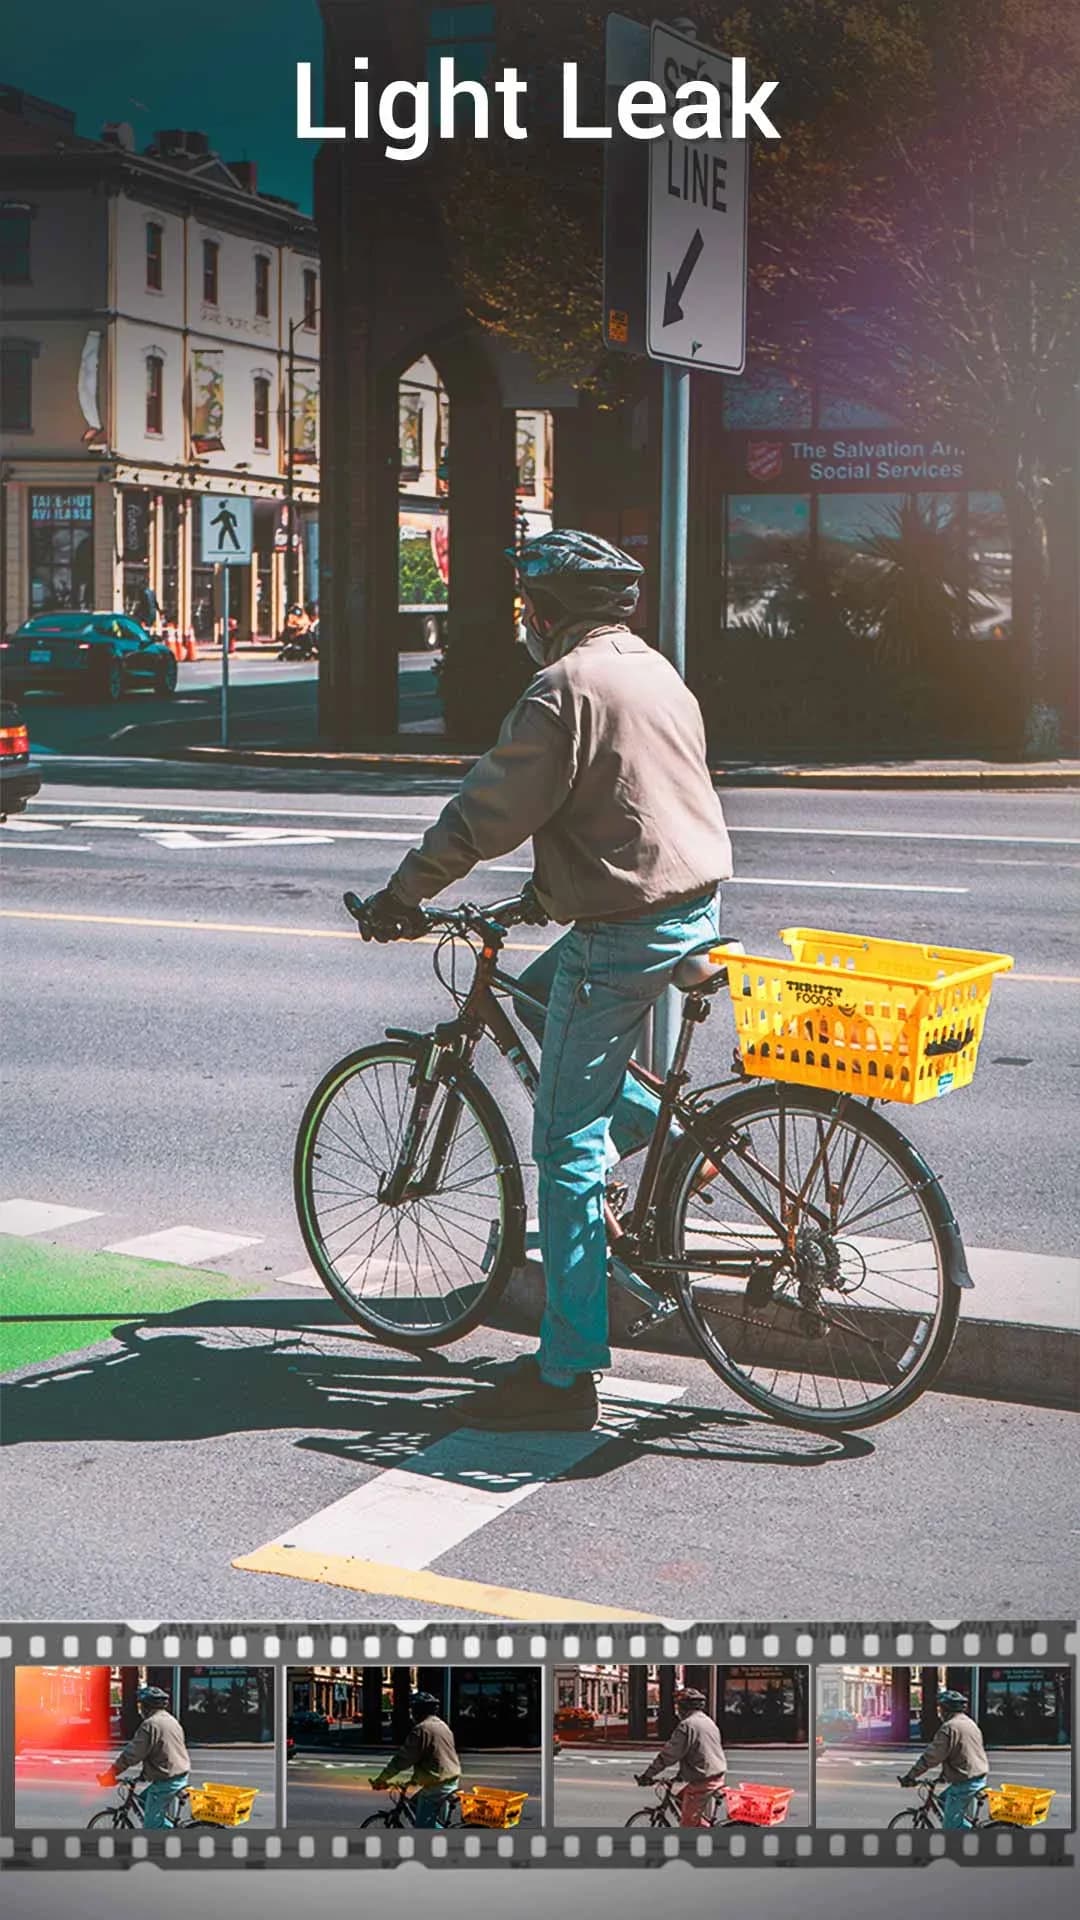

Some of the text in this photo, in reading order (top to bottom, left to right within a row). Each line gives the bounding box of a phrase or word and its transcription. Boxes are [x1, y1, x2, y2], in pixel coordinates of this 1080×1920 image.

[668, 140, 728, 213] LINE
[791, 442, 826, 458] The
[833, 441, 925, 458] Salvation
[810, 461, 963, 480] Social Services
[786, 980, 843, 997] THRIFTY
[796, 992, 834, 1008] FOODS
